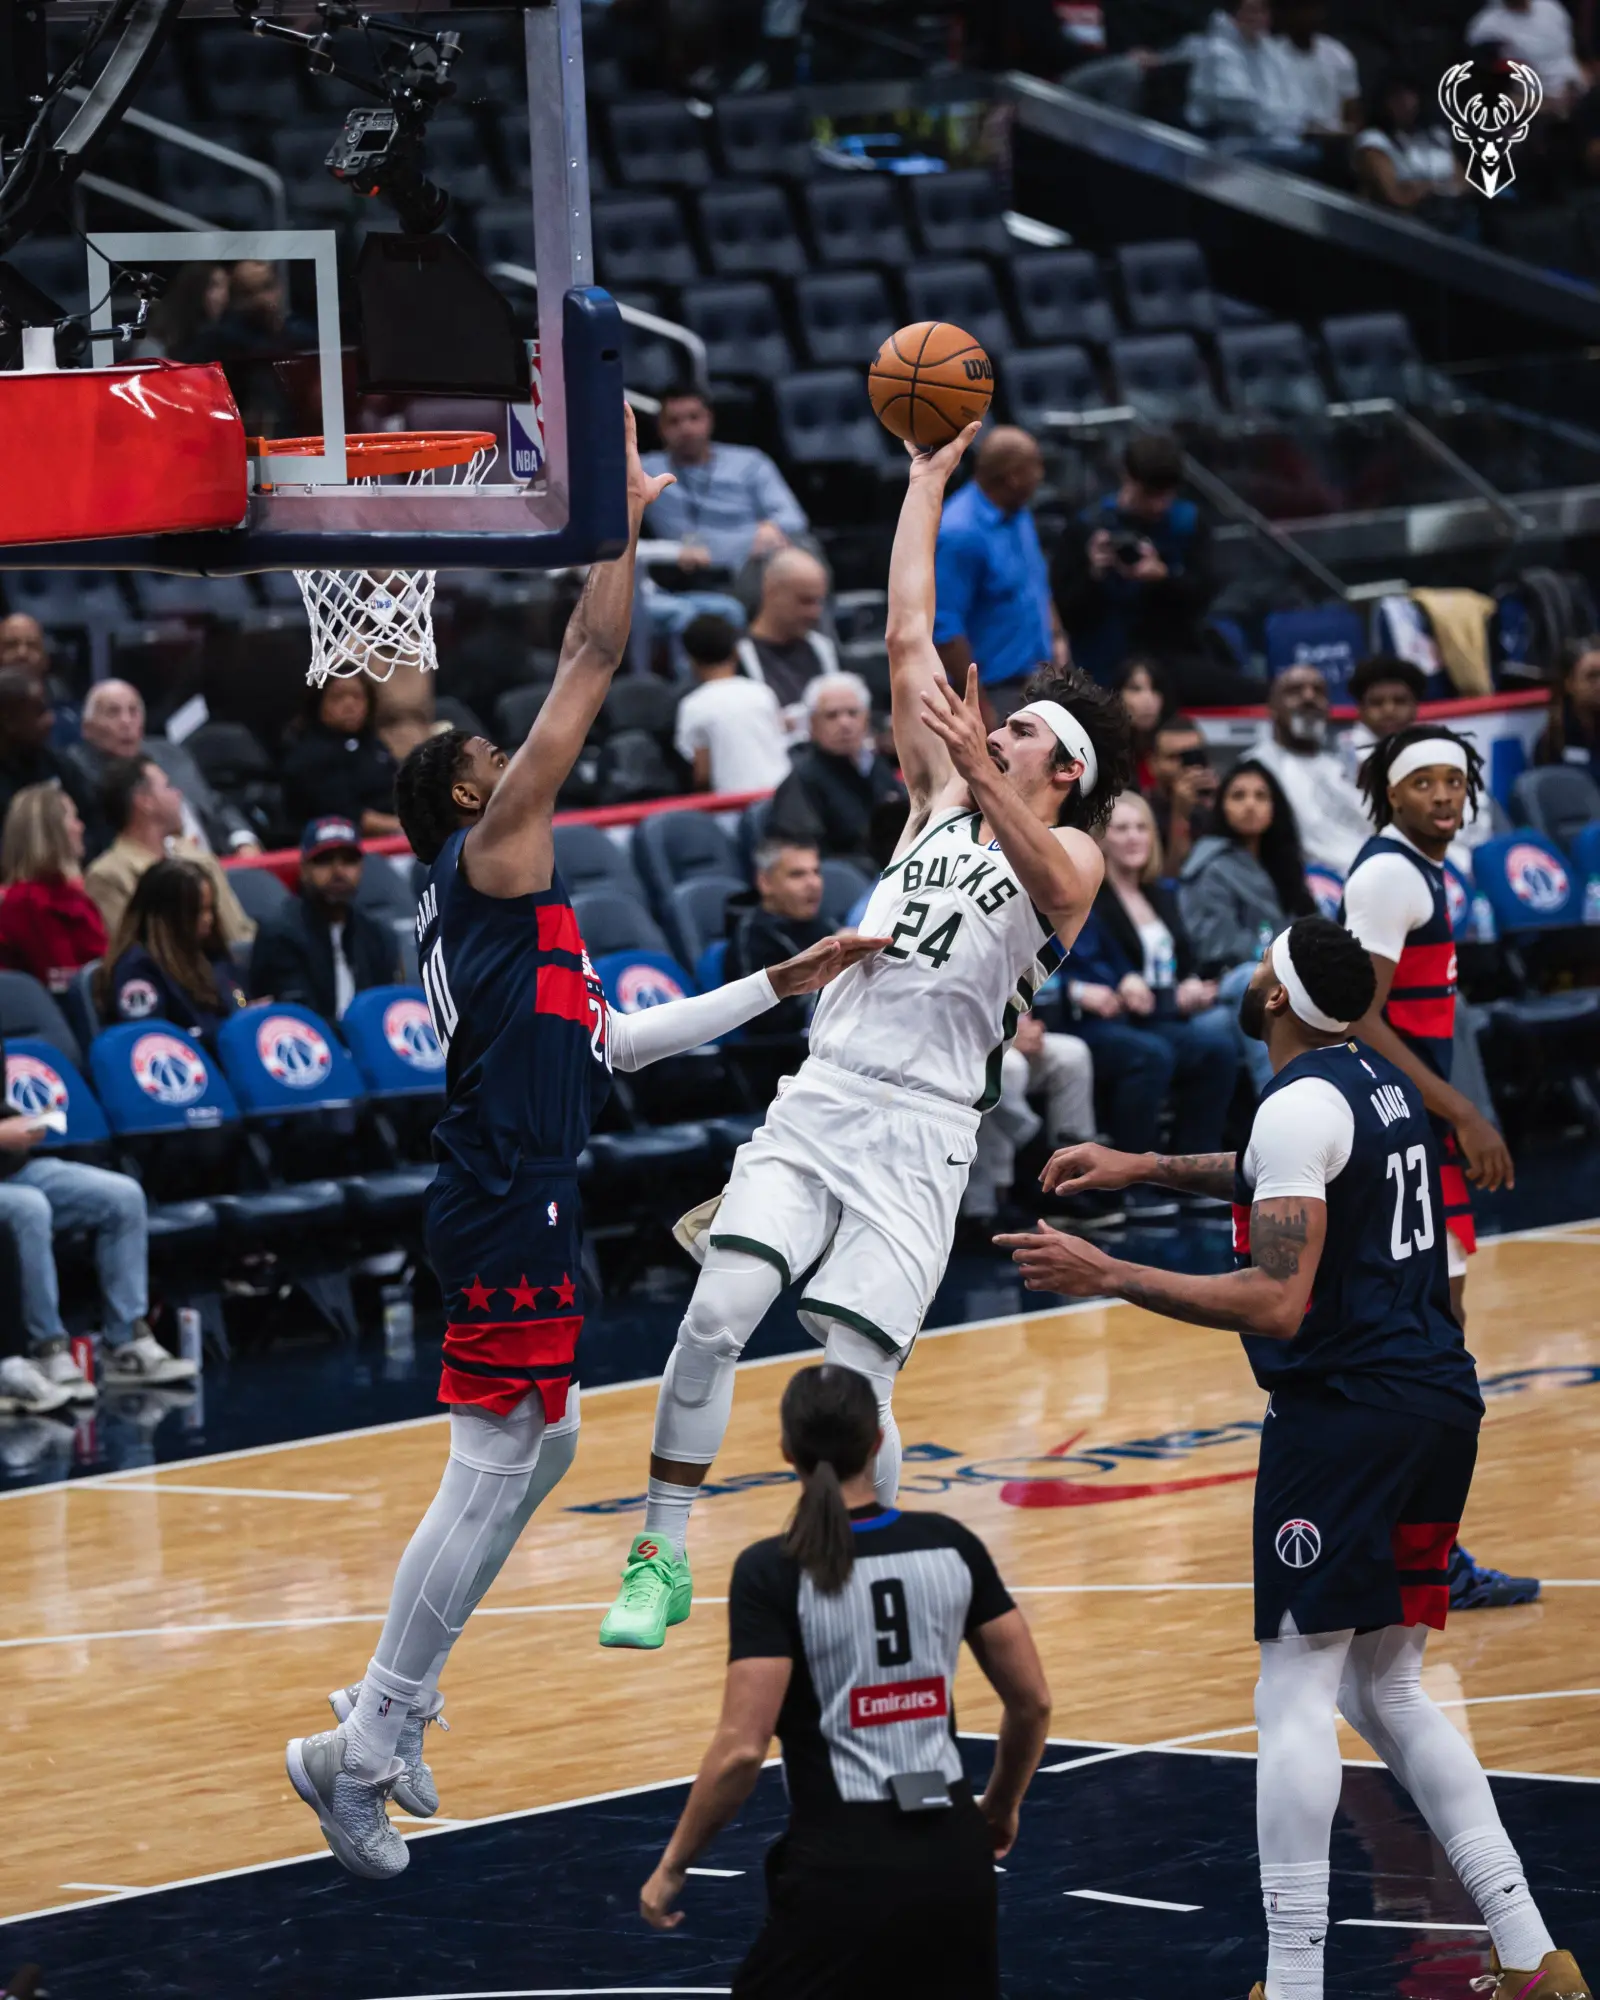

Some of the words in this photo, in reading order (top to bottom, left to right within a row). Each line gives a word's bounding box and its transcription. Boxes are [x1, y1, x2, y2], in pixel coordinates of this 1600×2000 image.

[515, 450, 539, 472] NBA
[903, 854, 1019, 916] BUCKS
[882, 900, 964, 969] 24
[1370, 1084, 1411, 1128] DAVIS
[1386, 1143, 1435, 1261] 23
[870, 1577, 913, 1668] 9
[857, 1690, 938, 1718] Emirates
